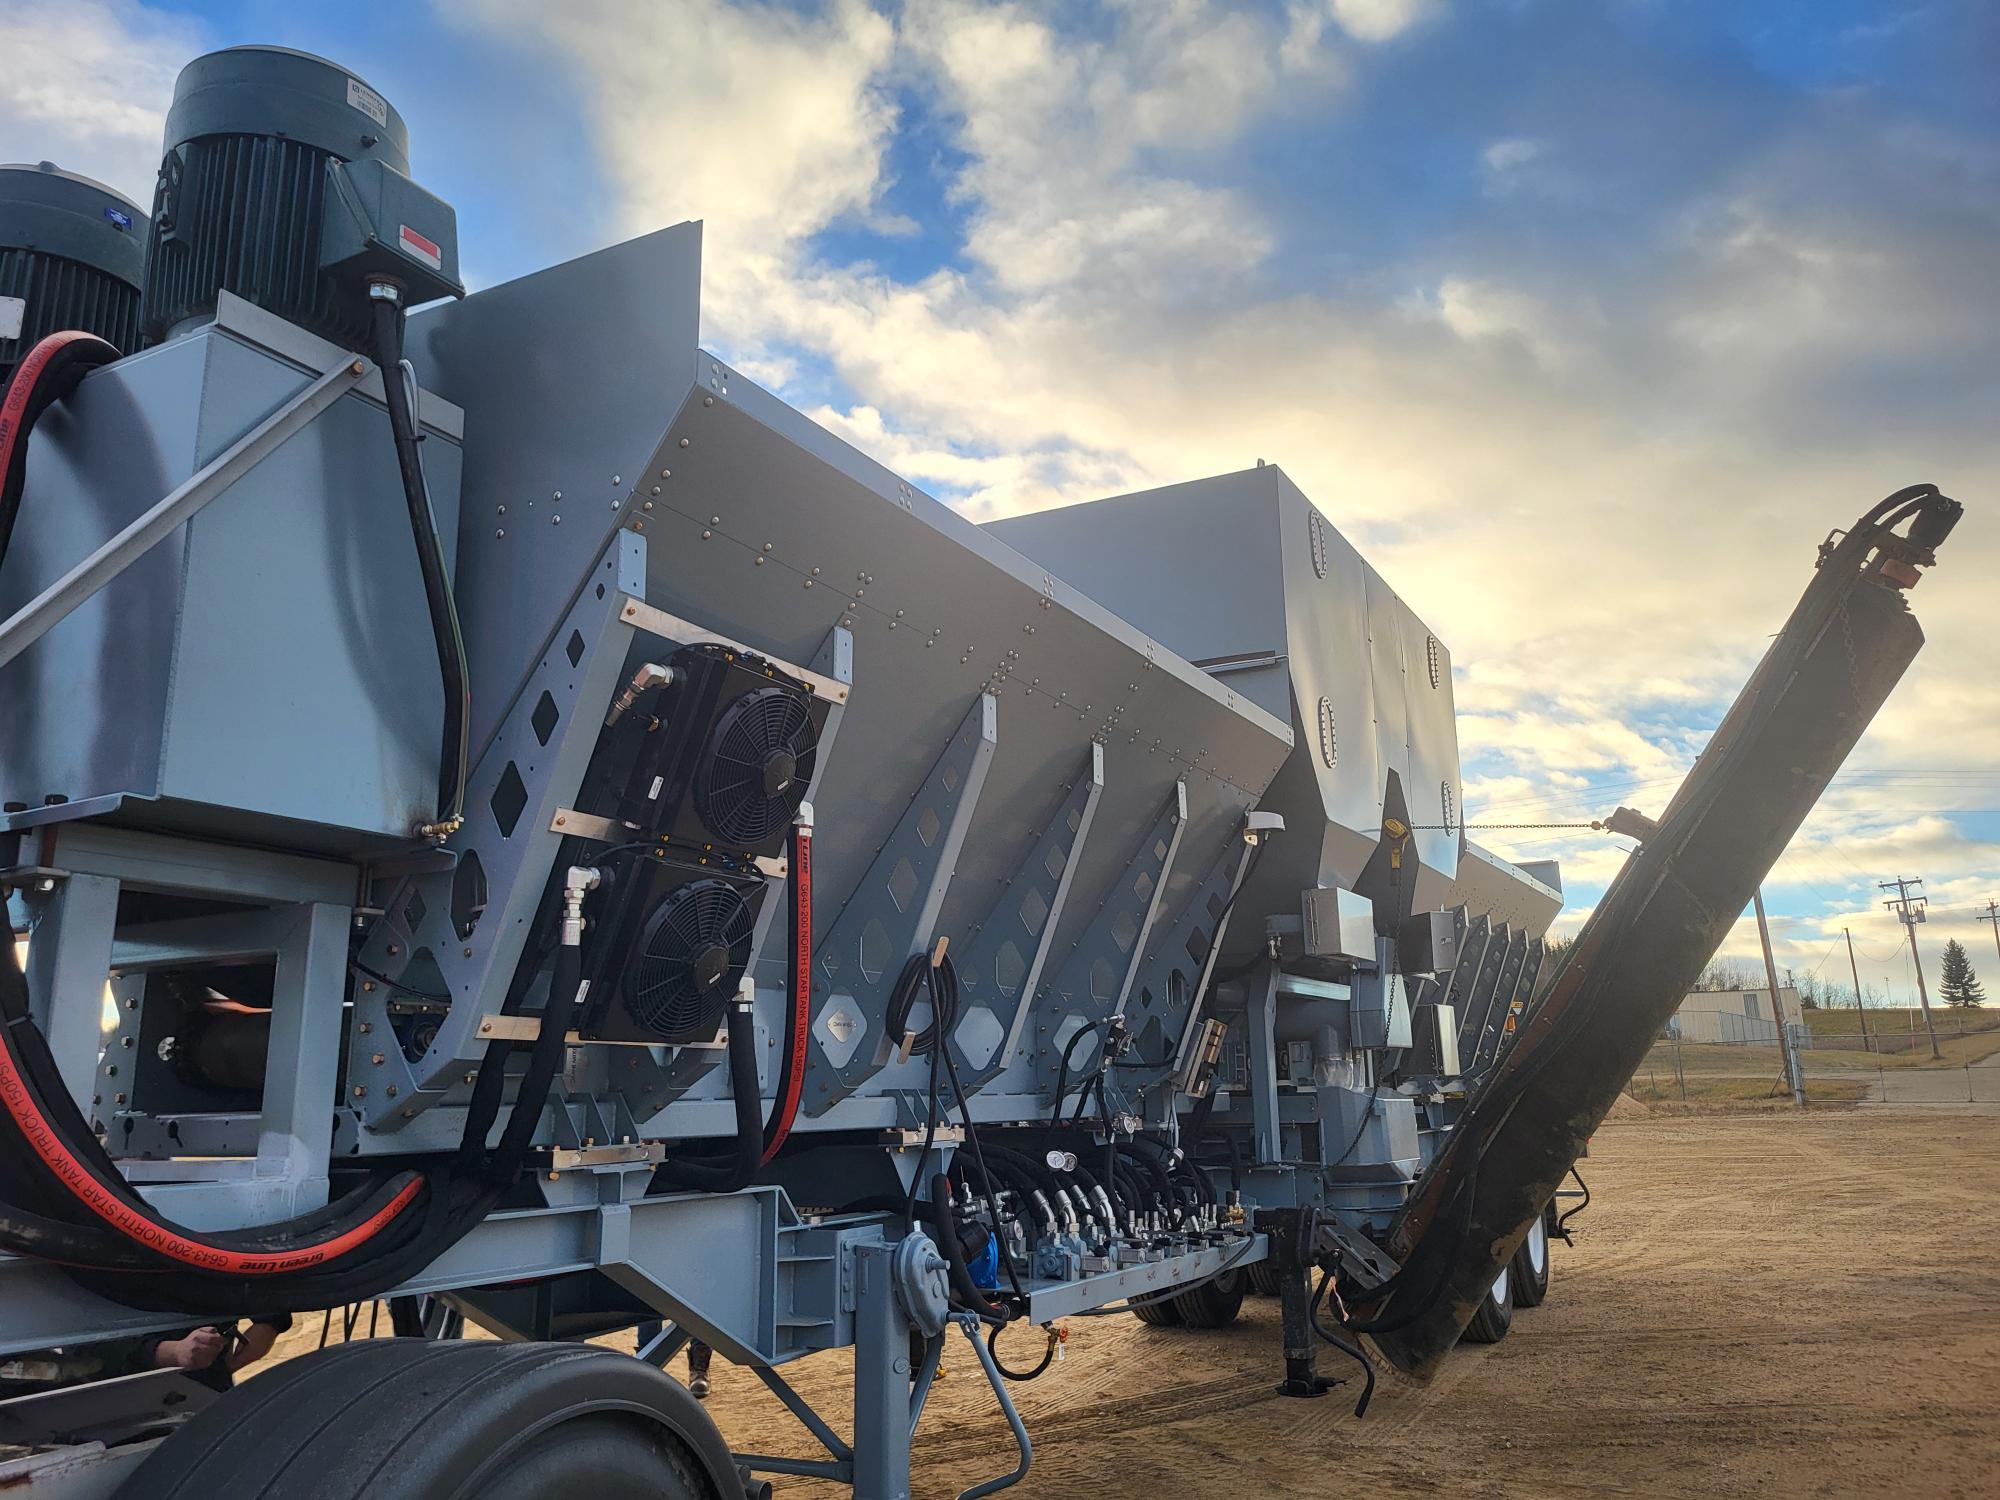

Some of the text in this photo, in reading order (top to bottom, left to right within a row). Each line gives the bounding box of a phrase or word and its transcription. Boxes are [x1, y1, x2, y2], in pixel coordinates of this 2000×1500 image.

[800, 884, 808, 928] G643-200
[800, 931, 809, 965] NORTH
[799, 967, 808, 993] STAR
[796, 995, 808, 1021] TANK
[795, 1023, 807, 1054] TRUCK
[18, 1108, 55, 1155] TRUCK
[51, 1153, 86, 1189] TANK
[82, 1184, 118, 1215] STAR
[116, 1213, 167, 1247] NORTH
[167, 1239, 229, 1267] G643-200
[239, 1259, 277, 1271] Line
[279, 1252, 325, 1270] Green
